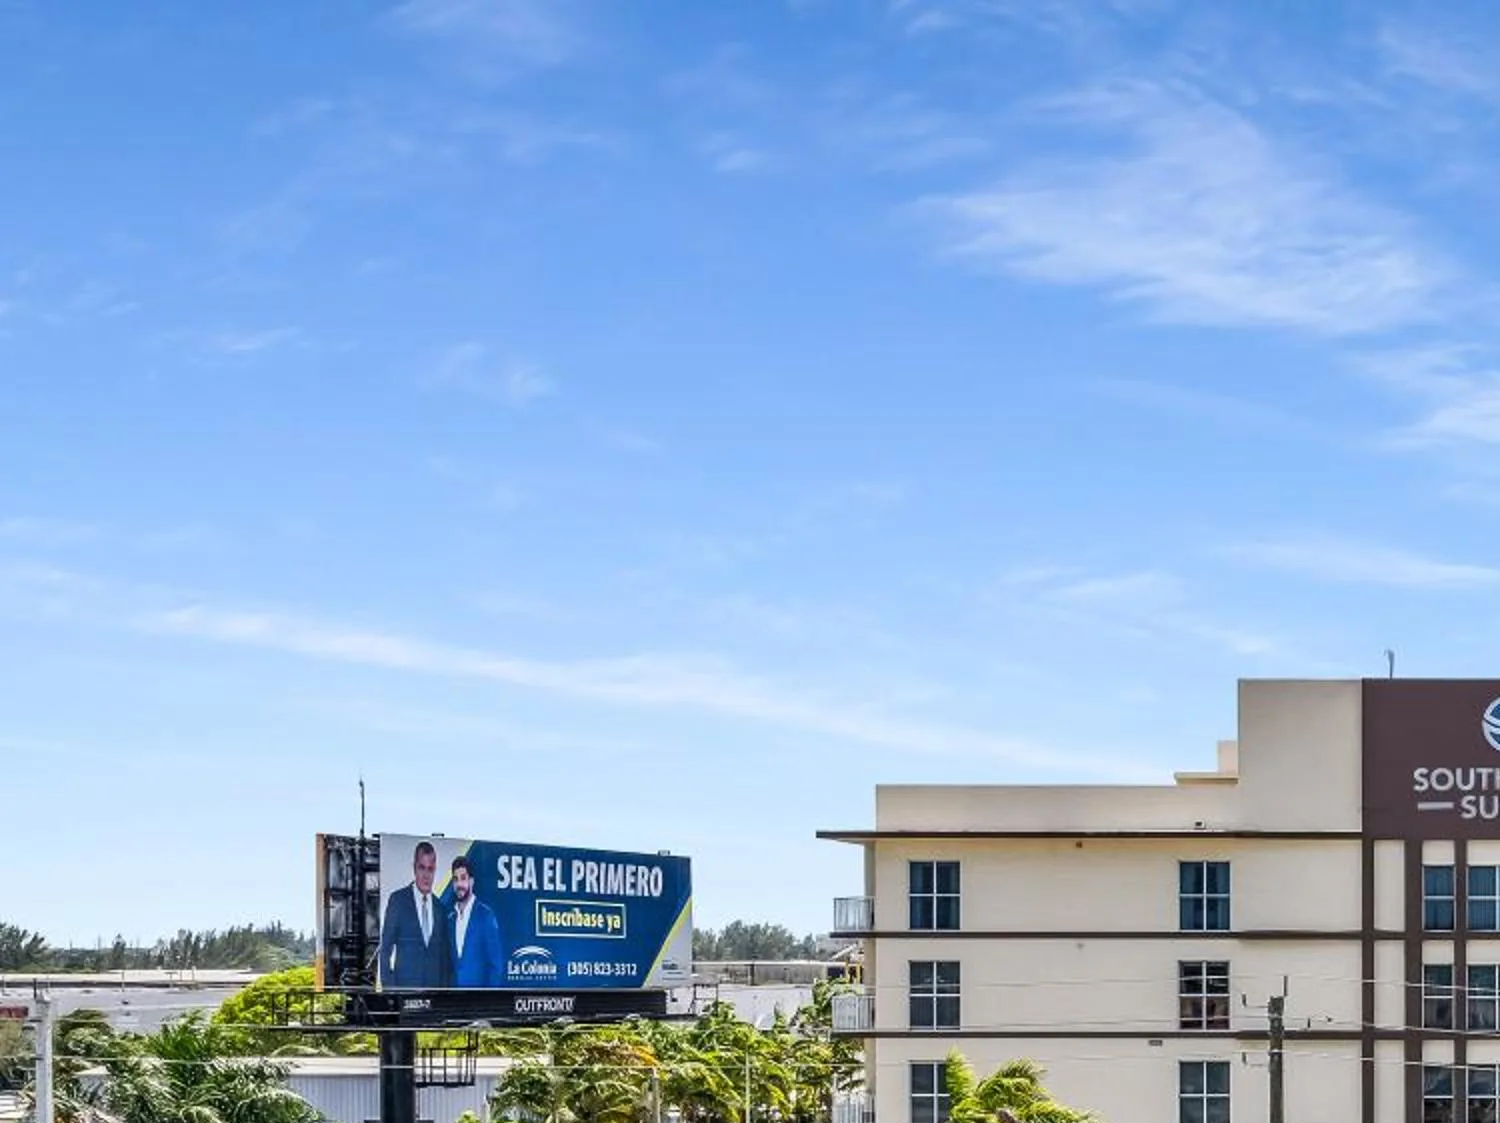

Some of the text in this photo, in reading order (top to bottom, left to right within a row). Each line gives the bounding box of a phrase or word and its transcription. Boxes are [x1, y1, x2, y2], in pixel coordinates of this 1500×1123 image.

[497, 854, 664, 897] SEA EL PRIMERO
[606, 914, 621, 934] ya
[507, 960, 520, 975] La
[567, 961, 638, 977] (305) 823-3312
